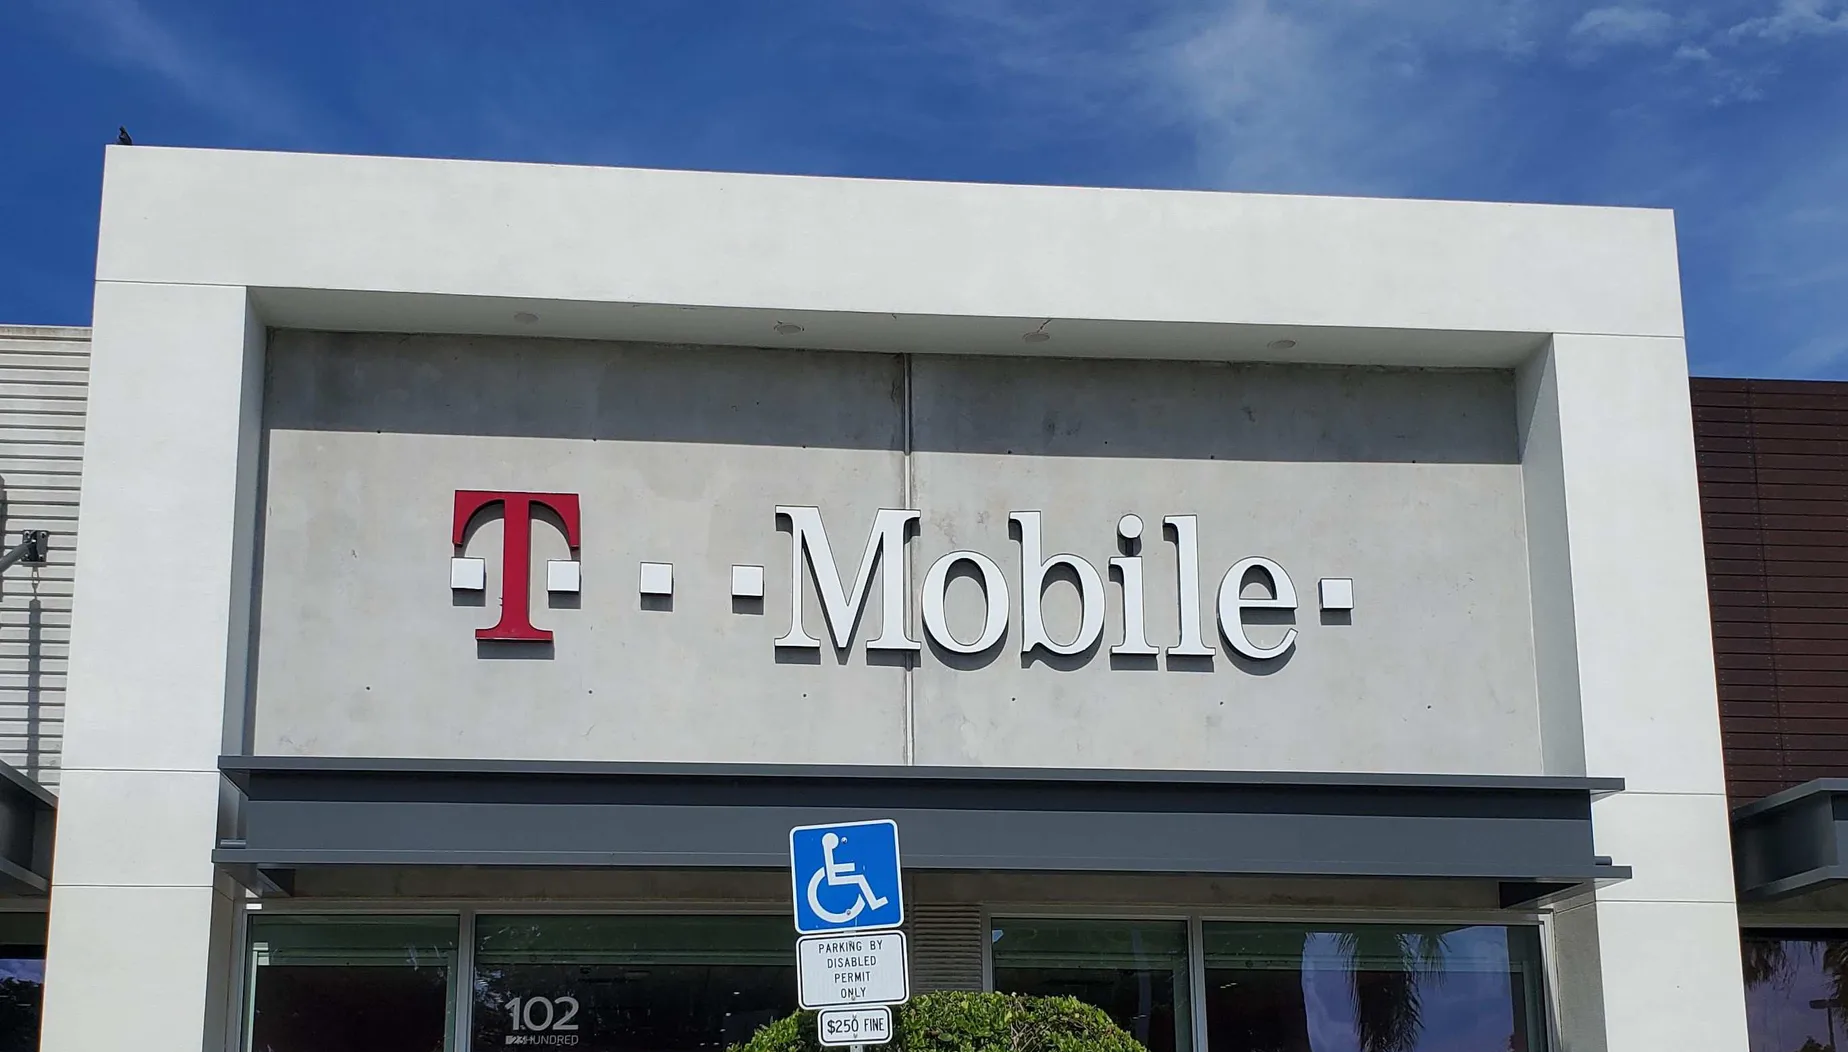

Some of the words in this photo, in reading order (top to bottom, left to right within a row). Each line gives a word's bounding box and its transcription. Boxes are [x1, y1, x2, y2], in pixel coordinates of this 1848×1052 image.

[774, 504, 1298, 660] Mobile
[818, 940, 862, 954] PARKING
[870, 939, 883, 951] BY
[827, 955, 877, 968] DISABLED
[834, 971, 870, 983] PERMIT
[840, 987, 867, 999] ONLY
[505, 996, 579, 1031] 102
[827, 1017, 859, 1035] $250
[864, 1017, 884, 1032] FINE
